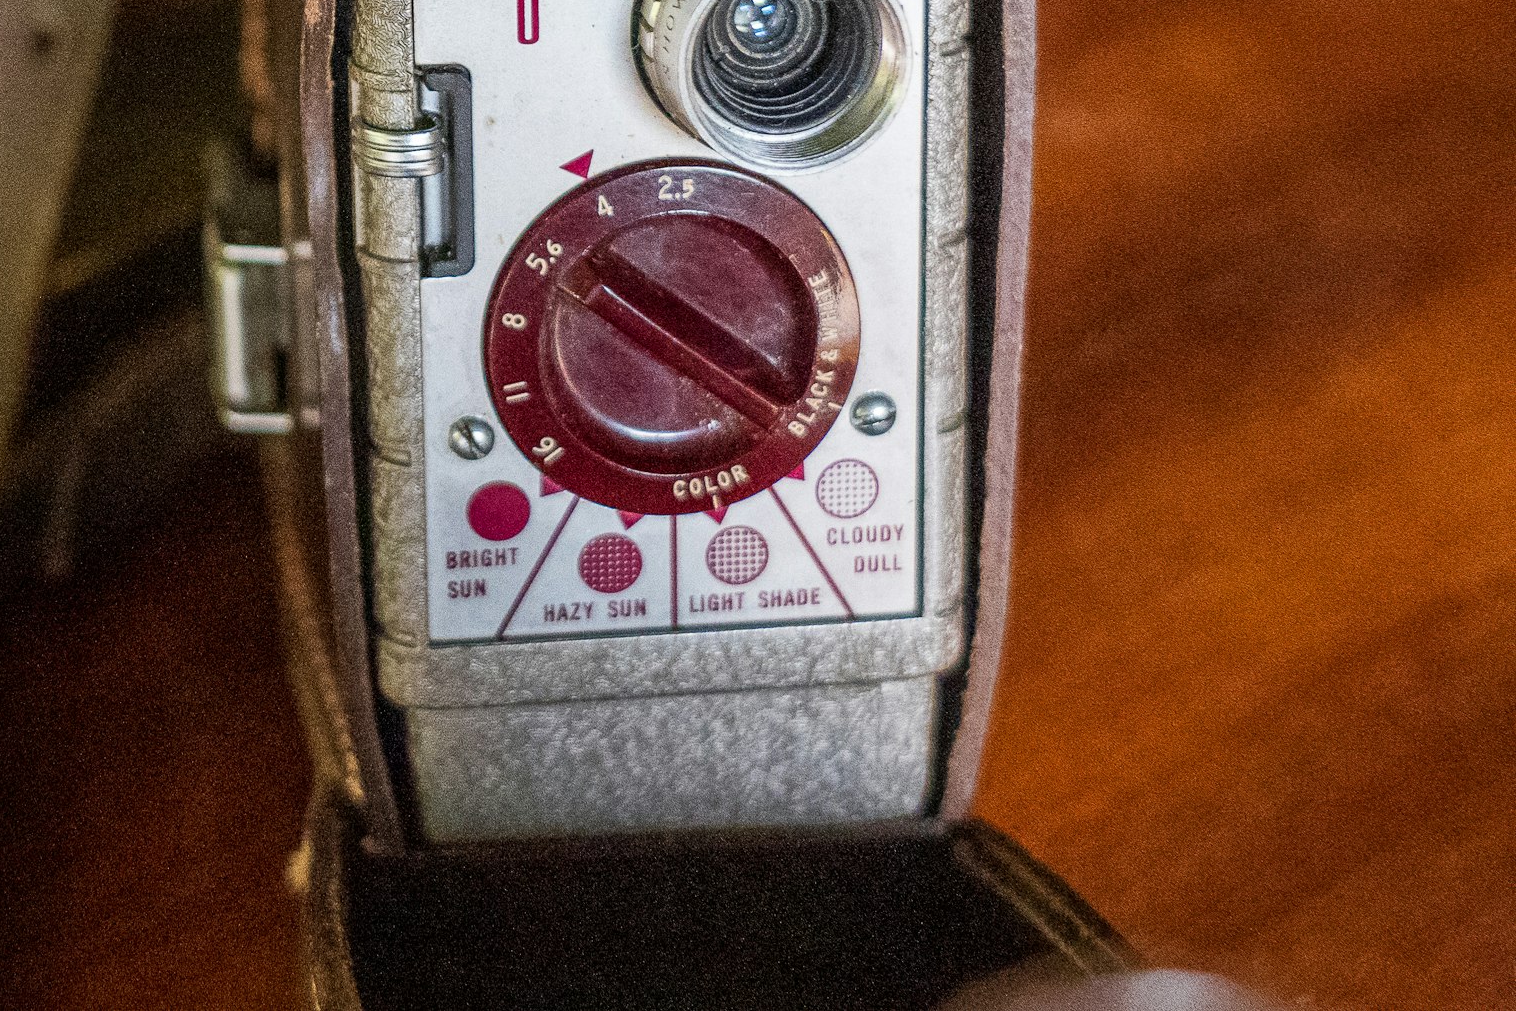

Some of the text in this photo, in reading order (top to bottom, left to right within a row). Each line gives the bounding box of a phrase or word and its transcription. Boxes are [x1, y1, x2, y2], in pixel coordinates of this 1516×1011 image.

[658, 174, 694, 201] 2.5
[597, 194, 614, 217] 4
[525, 239, 563, 277] 5.6
[501, 312, 526, 329] 8
[787, 268, 839, 438] BLACK & WHITE
[503, 380, 530, 404] 11
[531, 436, 564, 465] 16
[672, 464, 750, 500] COLOR
[825, 524, 905, 546] CLOUDY
[445, 546, 520, 570] BRIGHT
[853, 554, 903, 575] DULL
[447, 579, 488, 600] SUN
[688, 587, 822, 614] LIGHT SHADE
[543, 598, 648, 624] HAZY SUN
